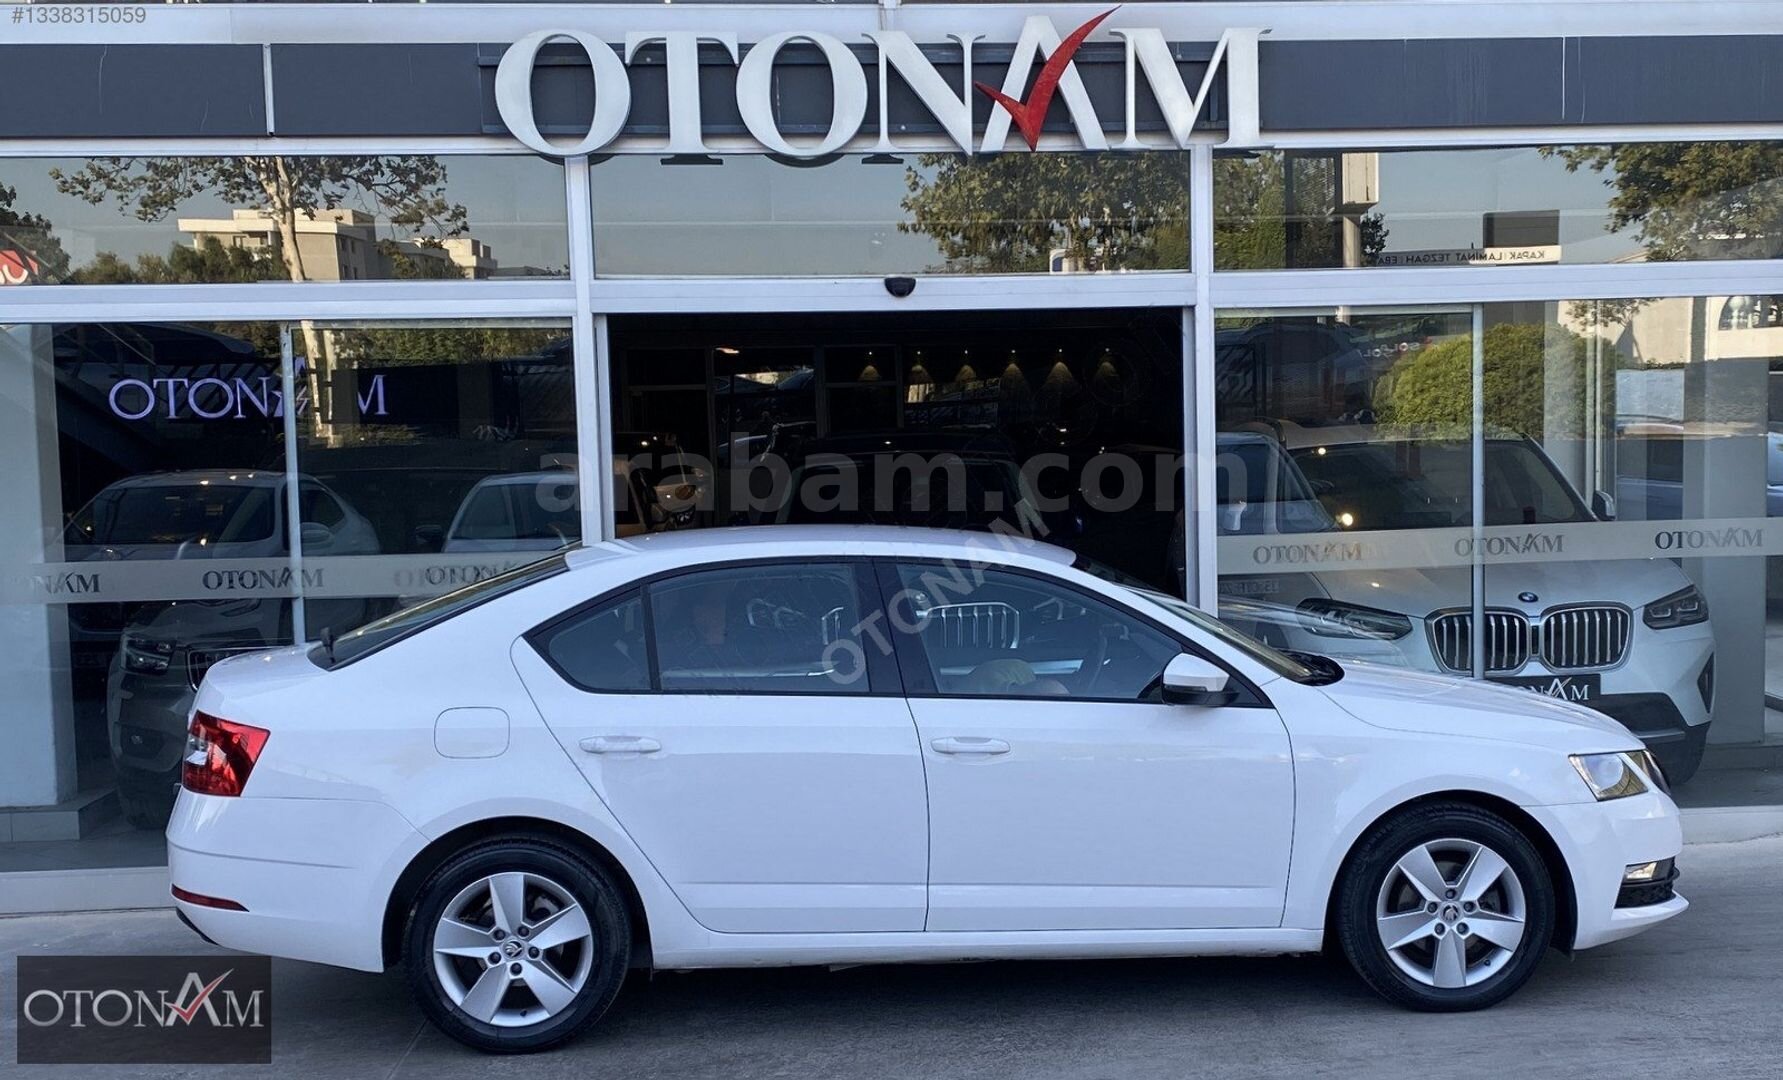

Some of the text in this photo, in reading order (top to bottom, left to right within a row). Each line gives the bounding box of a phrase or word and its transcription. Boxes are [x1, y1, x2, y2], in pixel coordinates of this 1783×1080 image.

[493, 8, 1271, 157] OTONAM
[1454, 532, 1564, 557] OTONAM
[1655, 527, 1764, 550] OTONAM
[1253, 541, 1363, 565] OTONAM
